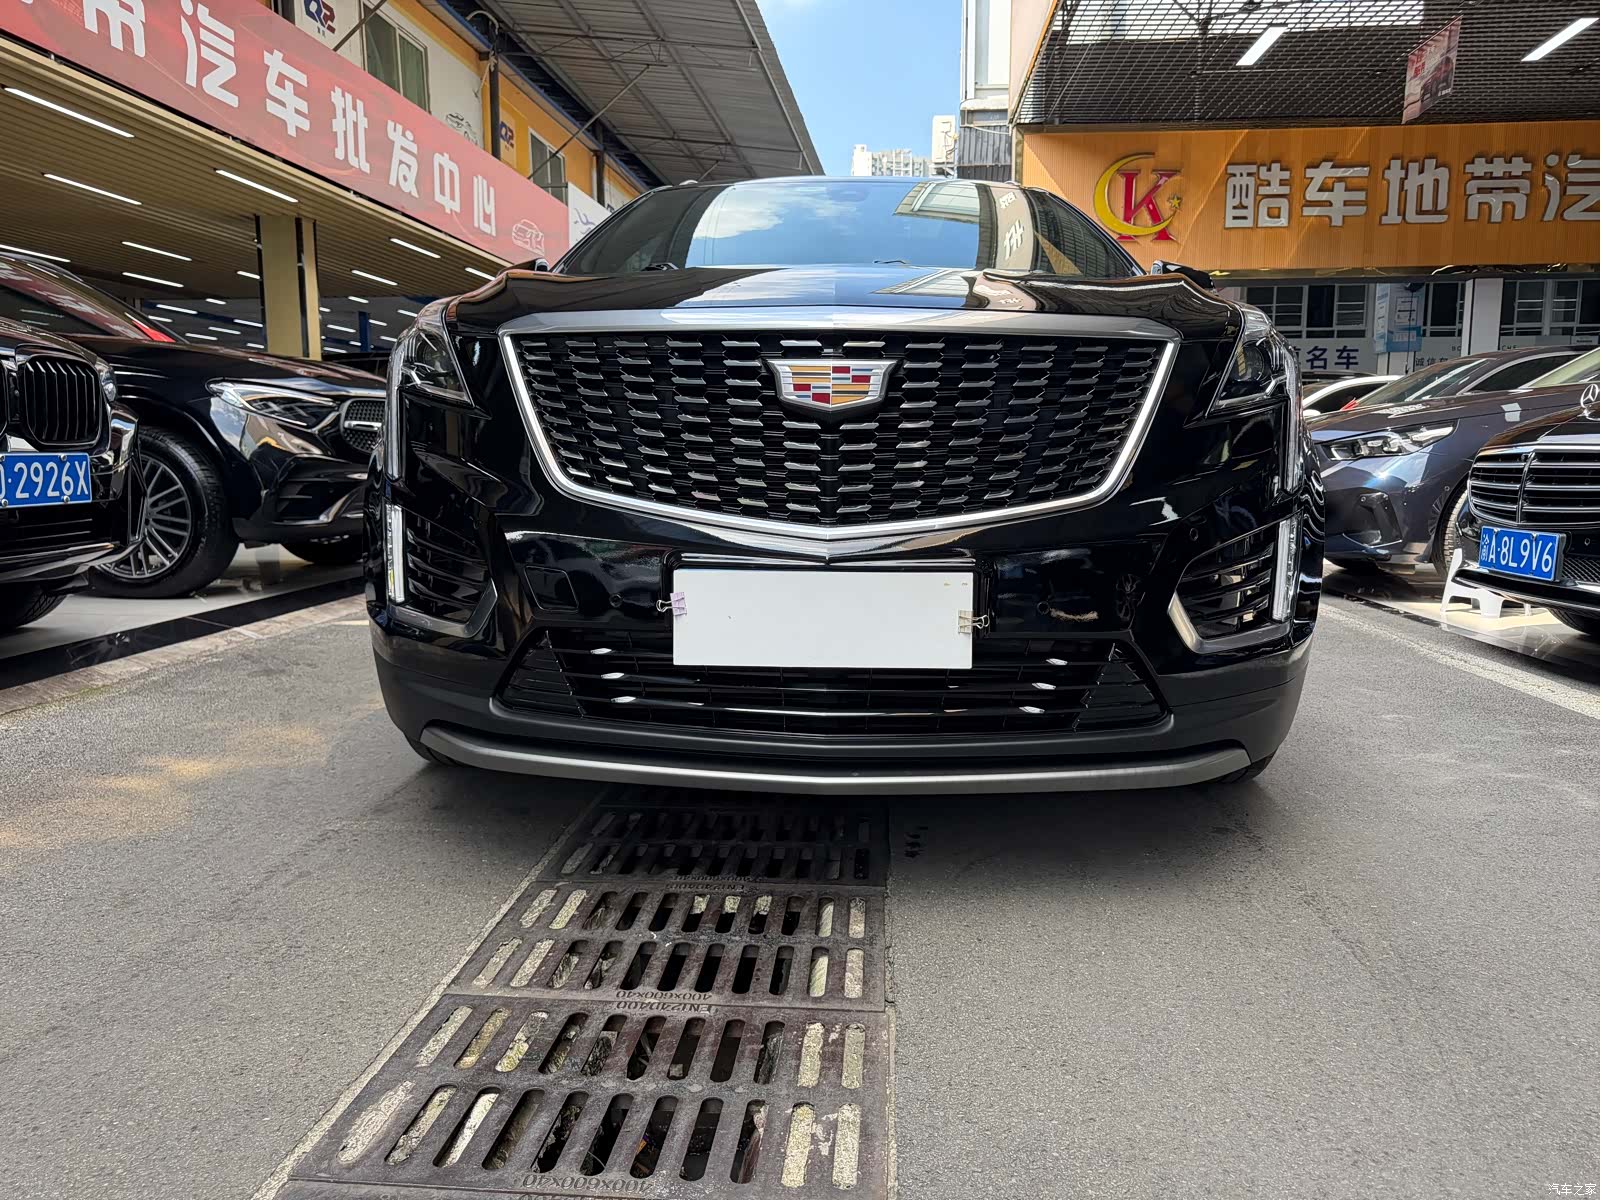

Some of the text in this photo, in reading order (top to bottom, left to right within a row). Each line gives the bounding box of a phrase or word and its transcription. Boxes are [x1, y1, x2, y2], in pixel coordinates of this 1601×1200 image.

[1224, 154, 1600, 228] 酷车地带汽
